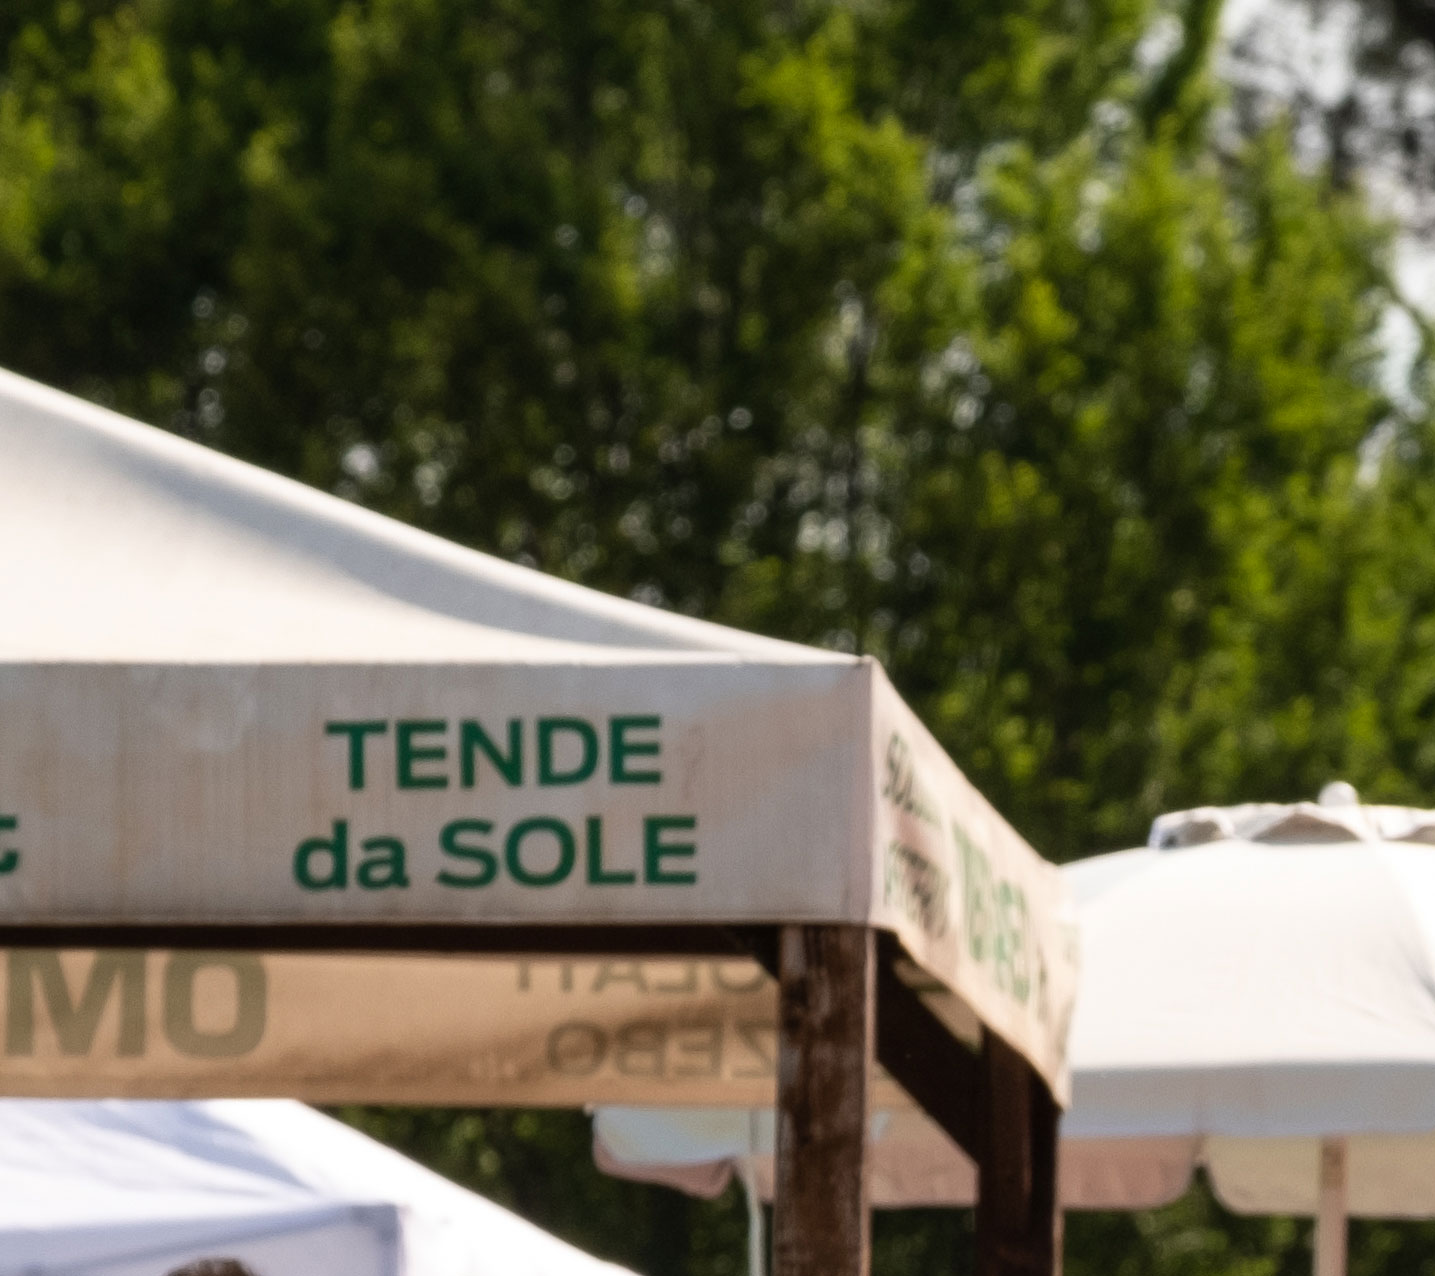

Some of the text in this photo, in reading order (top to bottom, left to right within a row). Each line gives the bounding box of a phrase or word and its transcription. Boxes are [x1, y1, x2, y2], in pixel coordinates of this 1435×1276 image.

[325, 714, 663, 790] TENDE
[292, 814, 698, 890] da SOLE
